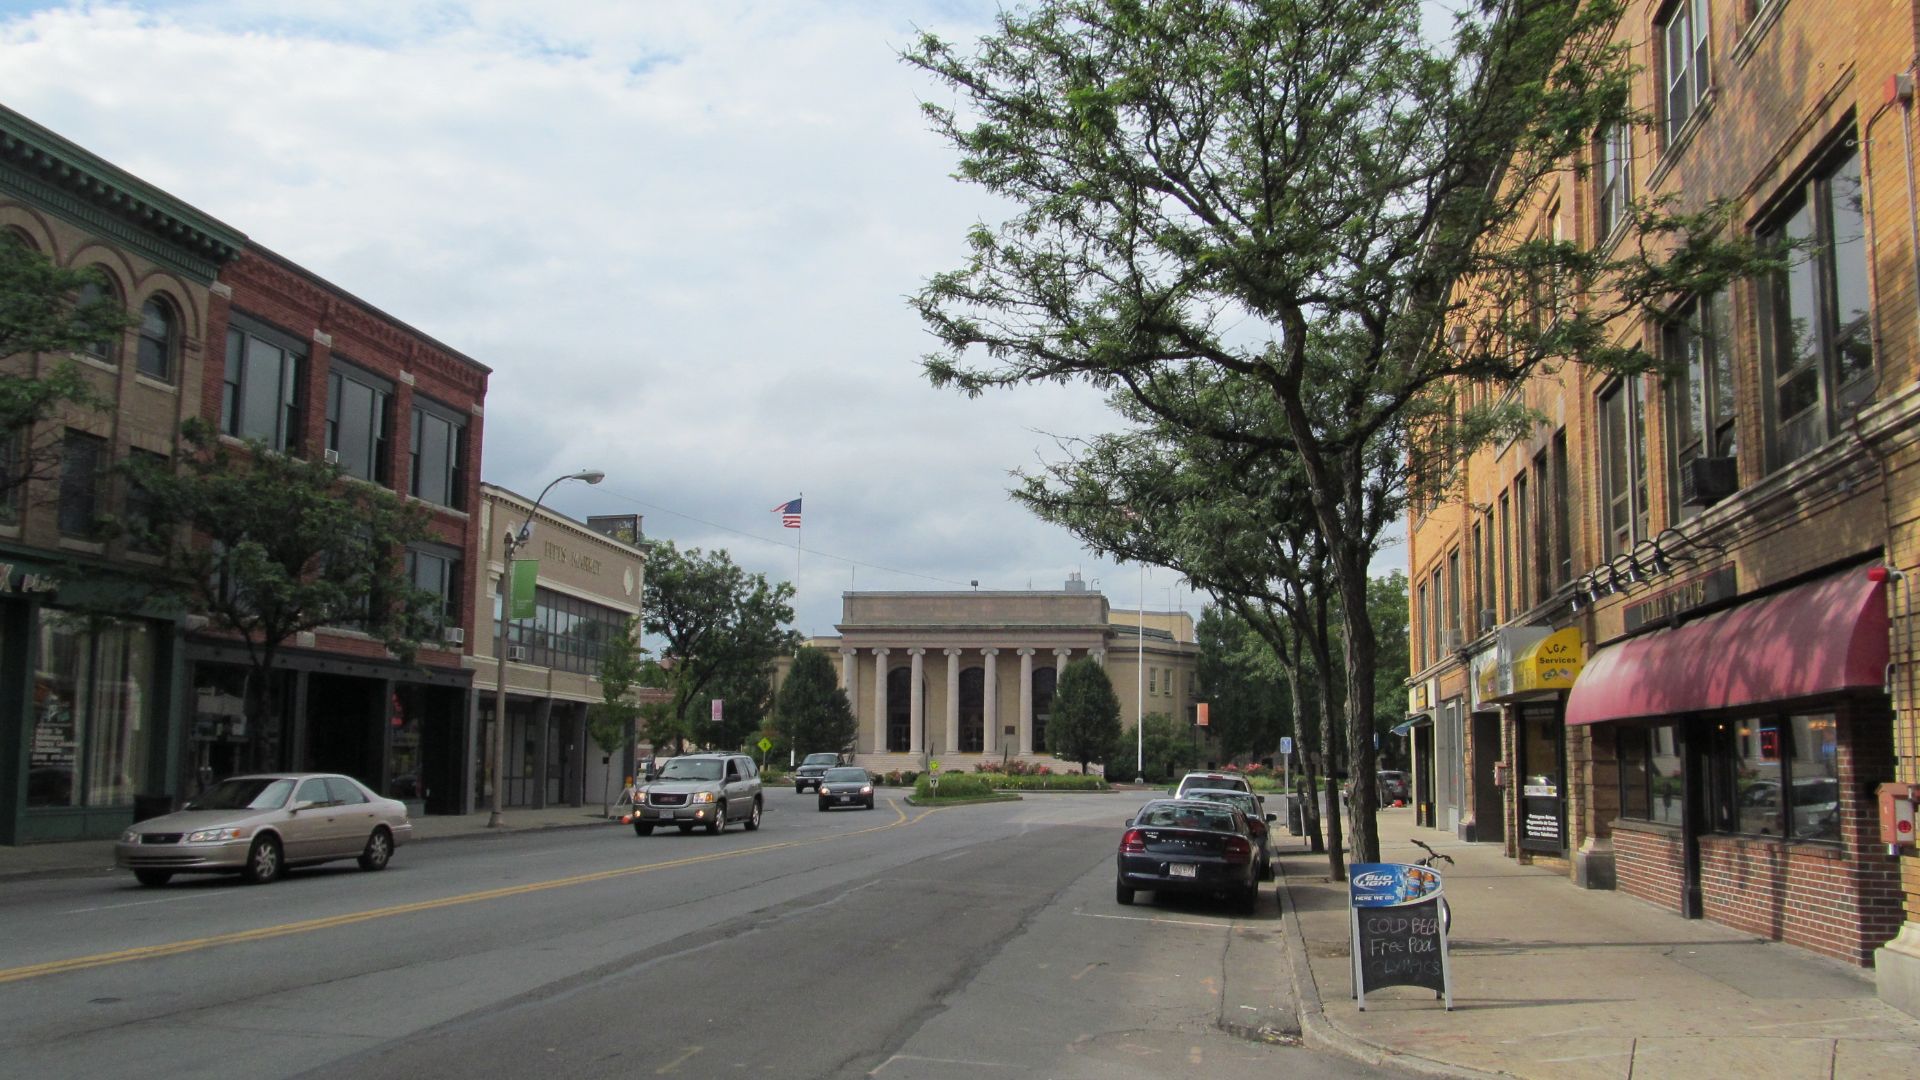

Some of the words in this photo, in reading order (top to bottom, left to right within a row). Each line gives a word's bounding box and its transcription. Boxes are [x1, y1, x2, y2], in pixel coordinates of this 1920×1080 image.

[1683, 579, 1705, 610] PUB
[1545, 643, 1568, 654] LGF
[1539, 656, 1577, 664] Services
[1367, 917, 1408, 935] COLD
[1368, 938, 1405, 957] Free
